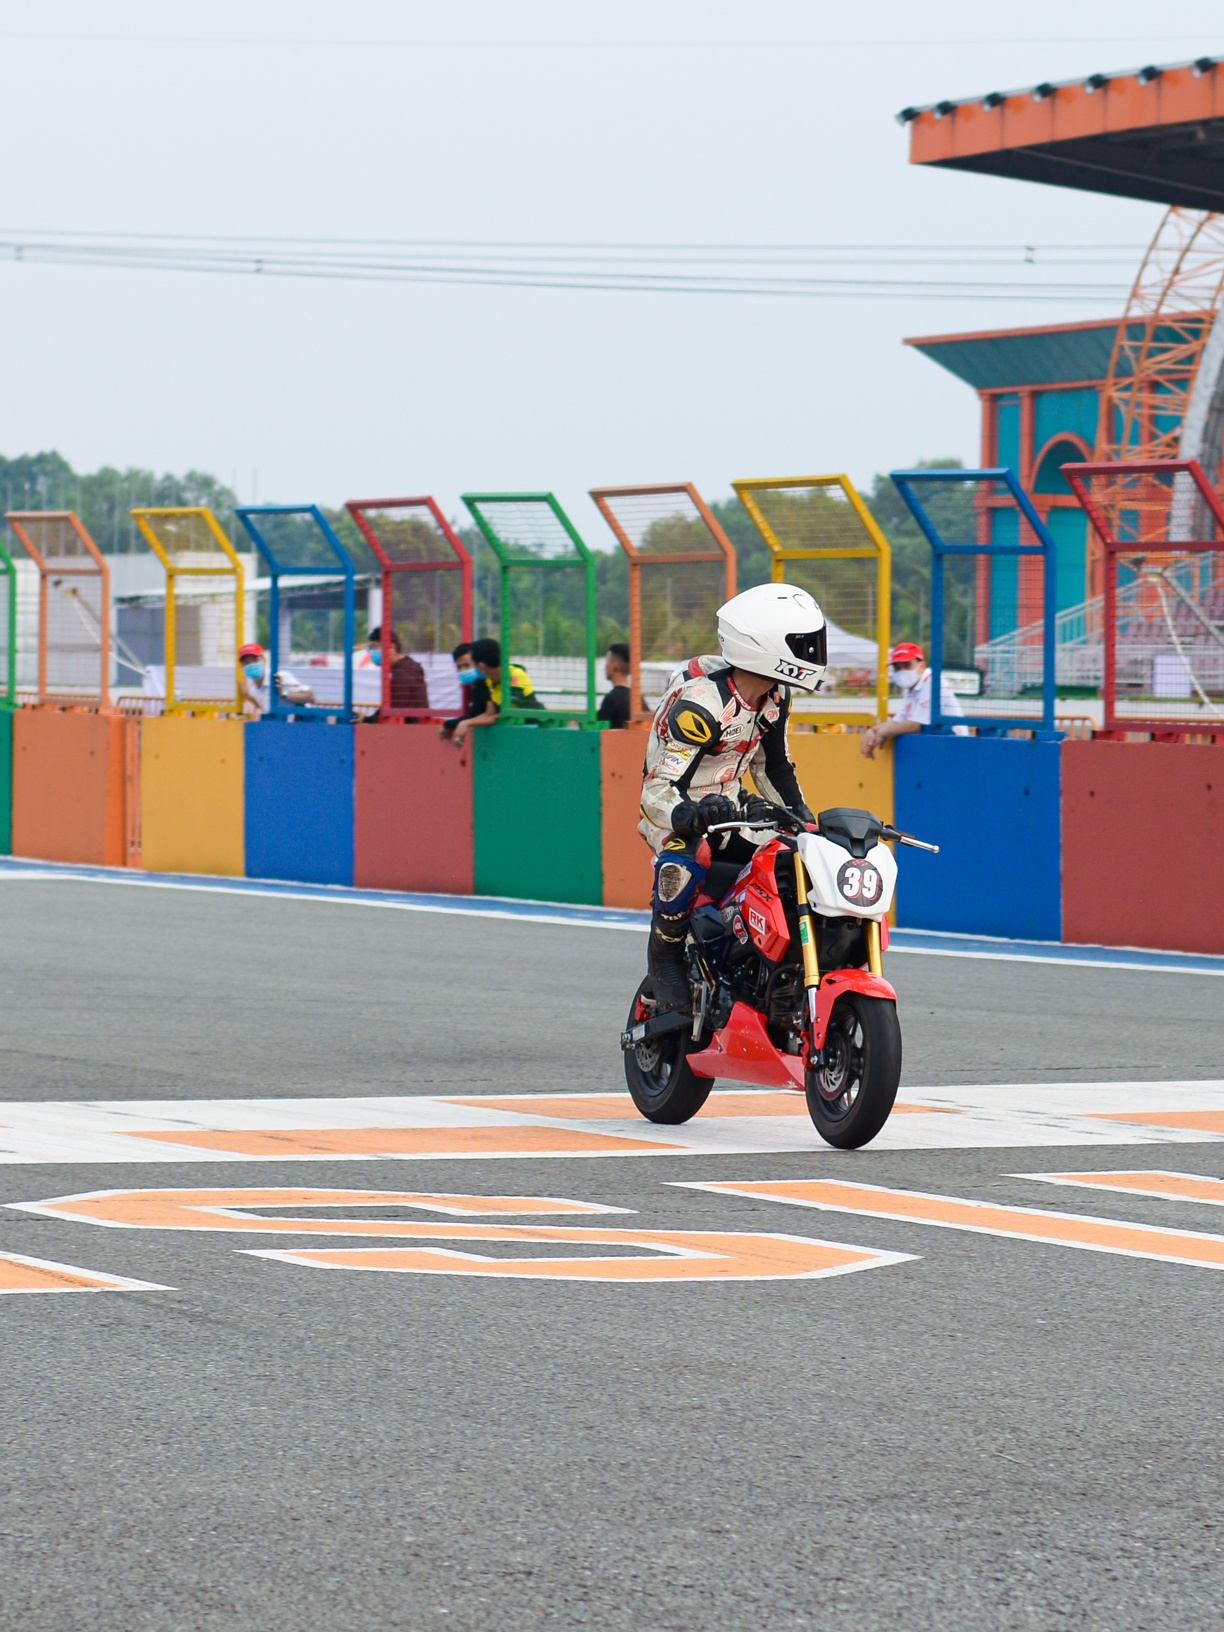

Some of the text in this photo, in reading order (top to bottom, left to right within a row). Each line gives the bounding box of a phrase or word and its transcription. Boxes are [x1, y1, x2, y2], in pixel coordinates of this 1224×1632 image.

[775, 659, 817, 681] KYT
[723, 726, 742, 738] HOEI
[844, 867, 879, 900] 39
[750, 909, 764, 929] RK
